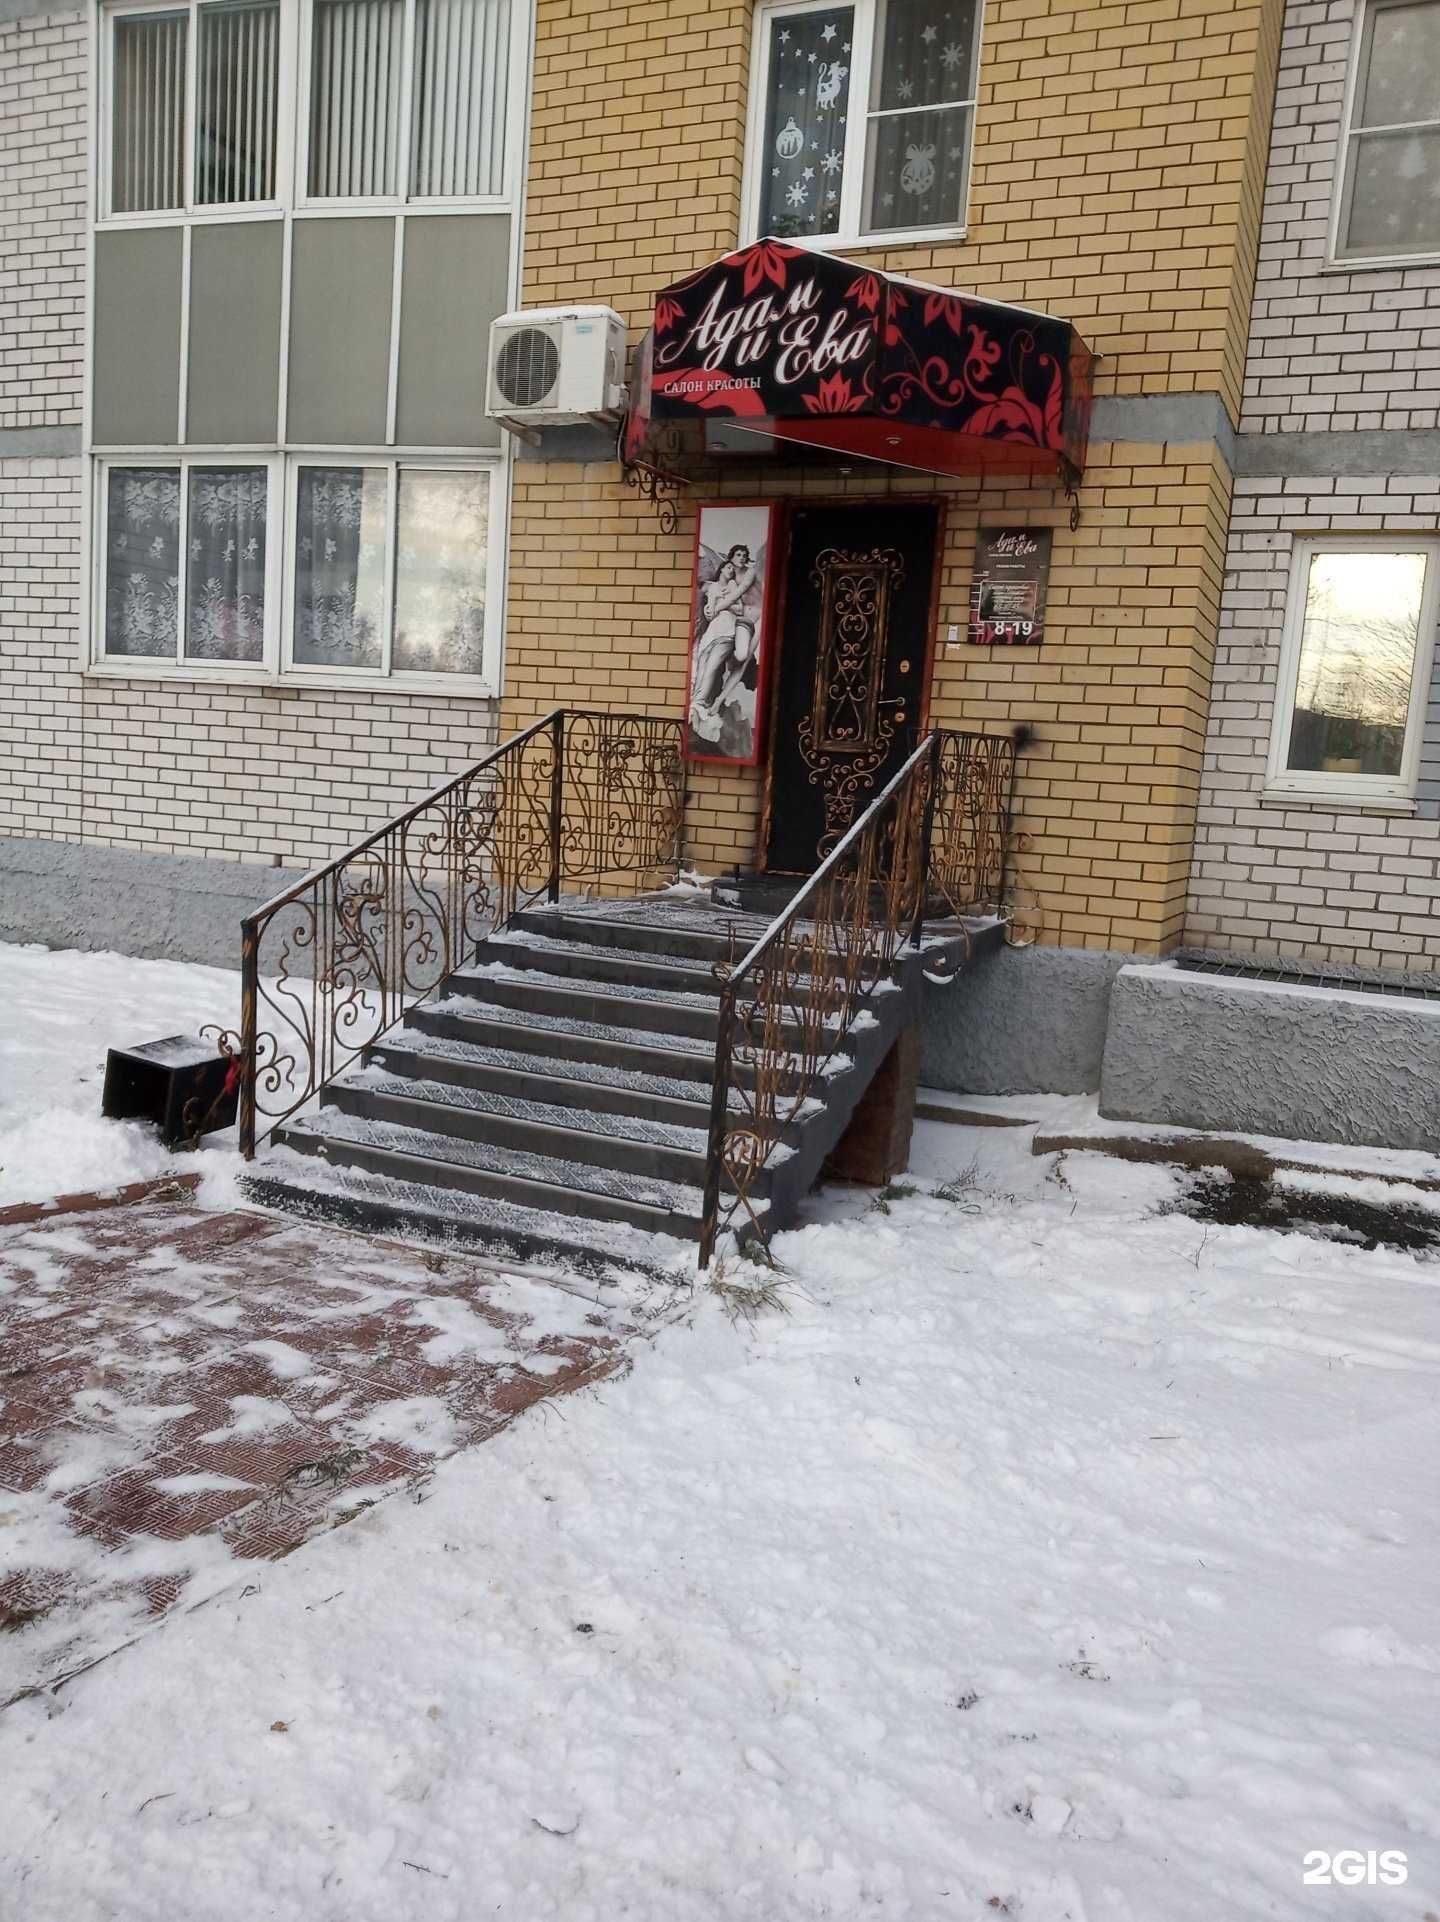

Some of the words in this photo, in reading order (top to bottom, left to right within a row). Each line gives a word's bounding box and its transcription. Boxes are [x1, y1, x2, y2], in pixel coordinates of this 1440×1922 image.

[658, 276, 824, 372] Адам
[734, 327, 770, 367] и
[773, 308, 871, 384] Ева
[663, 379, 703, 394] САЛОН
[706, 376, 761, 391] КРАСОТЫ
[994, 621, 1033, 636] 8-19
